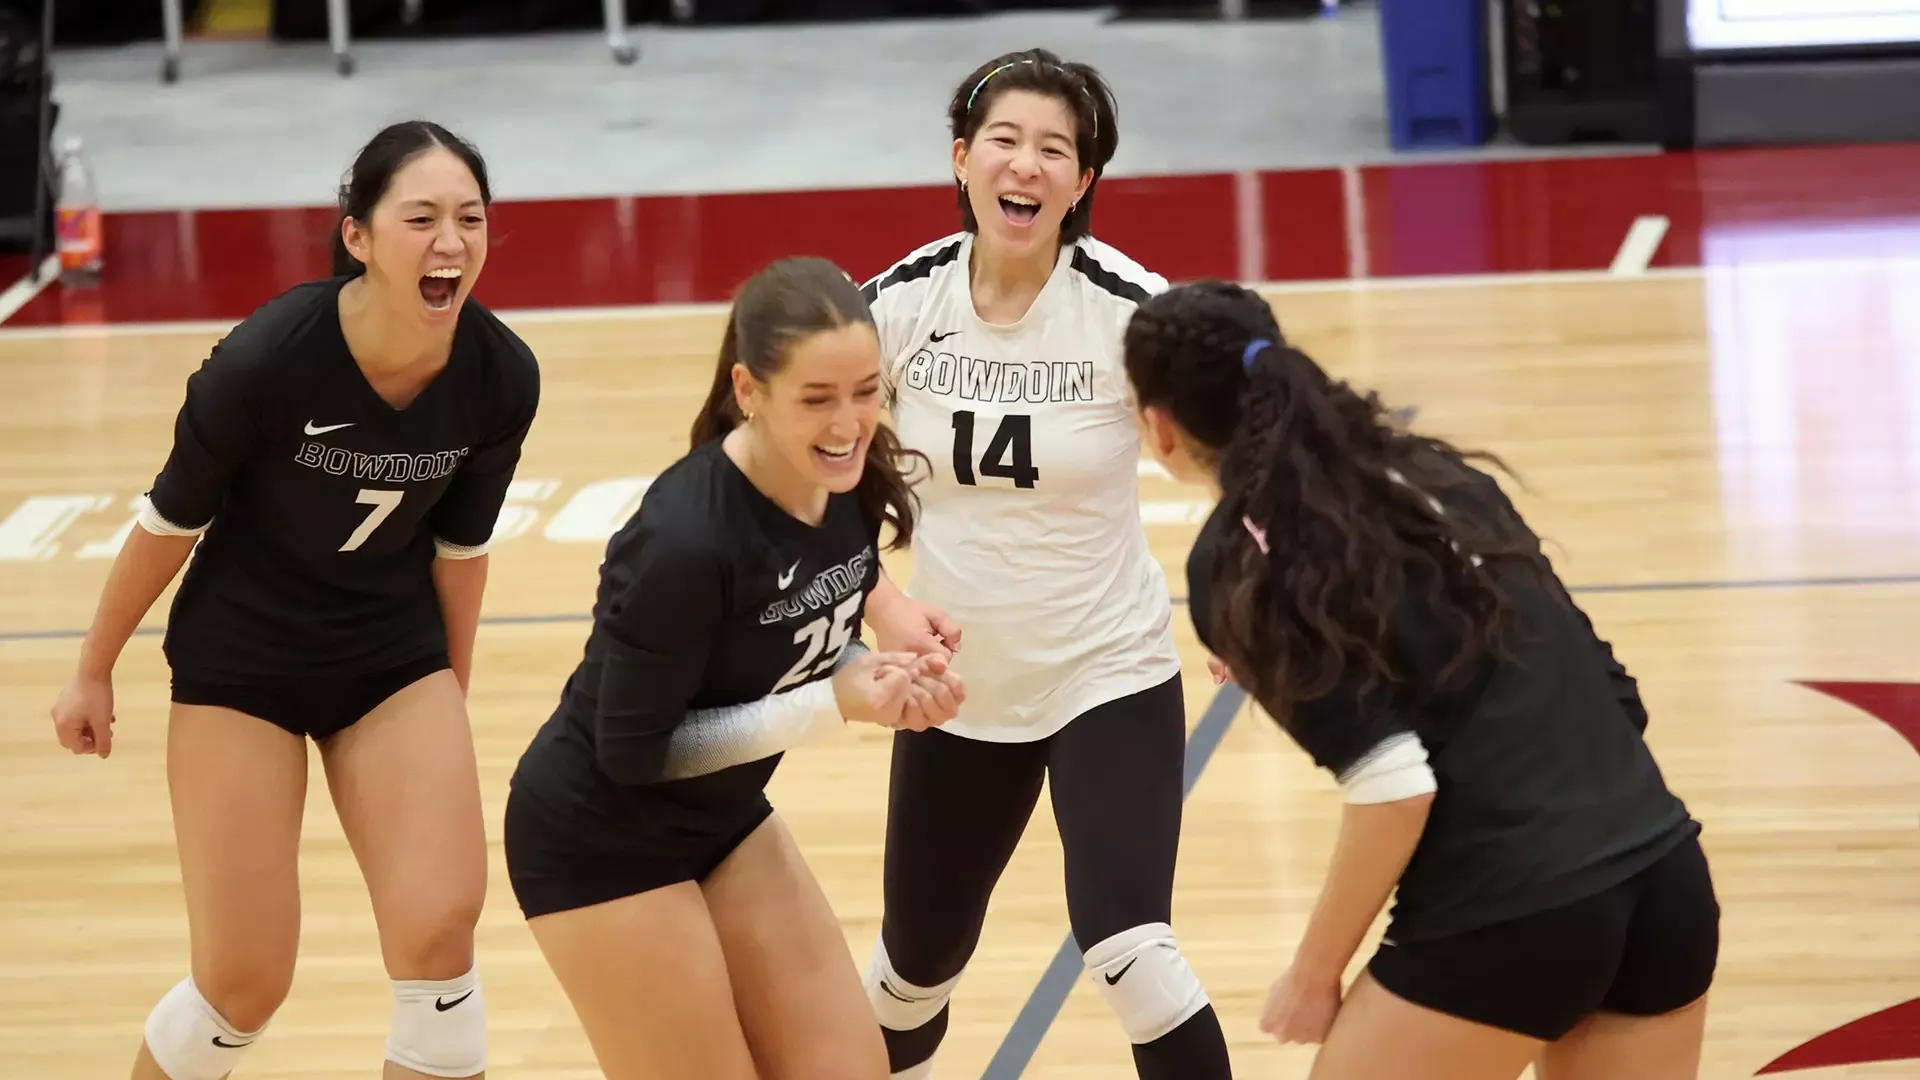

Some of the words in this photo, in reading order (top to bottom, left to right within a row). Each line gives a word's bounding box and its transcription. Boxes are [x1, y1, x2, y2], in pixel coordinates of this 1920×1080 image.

[905, 348, 1094, 404] BOWDOIN
[951, 409, 1040, 489] 14
[337, 488, 405, 553] 7
[770, 590, 863, 694] 25
